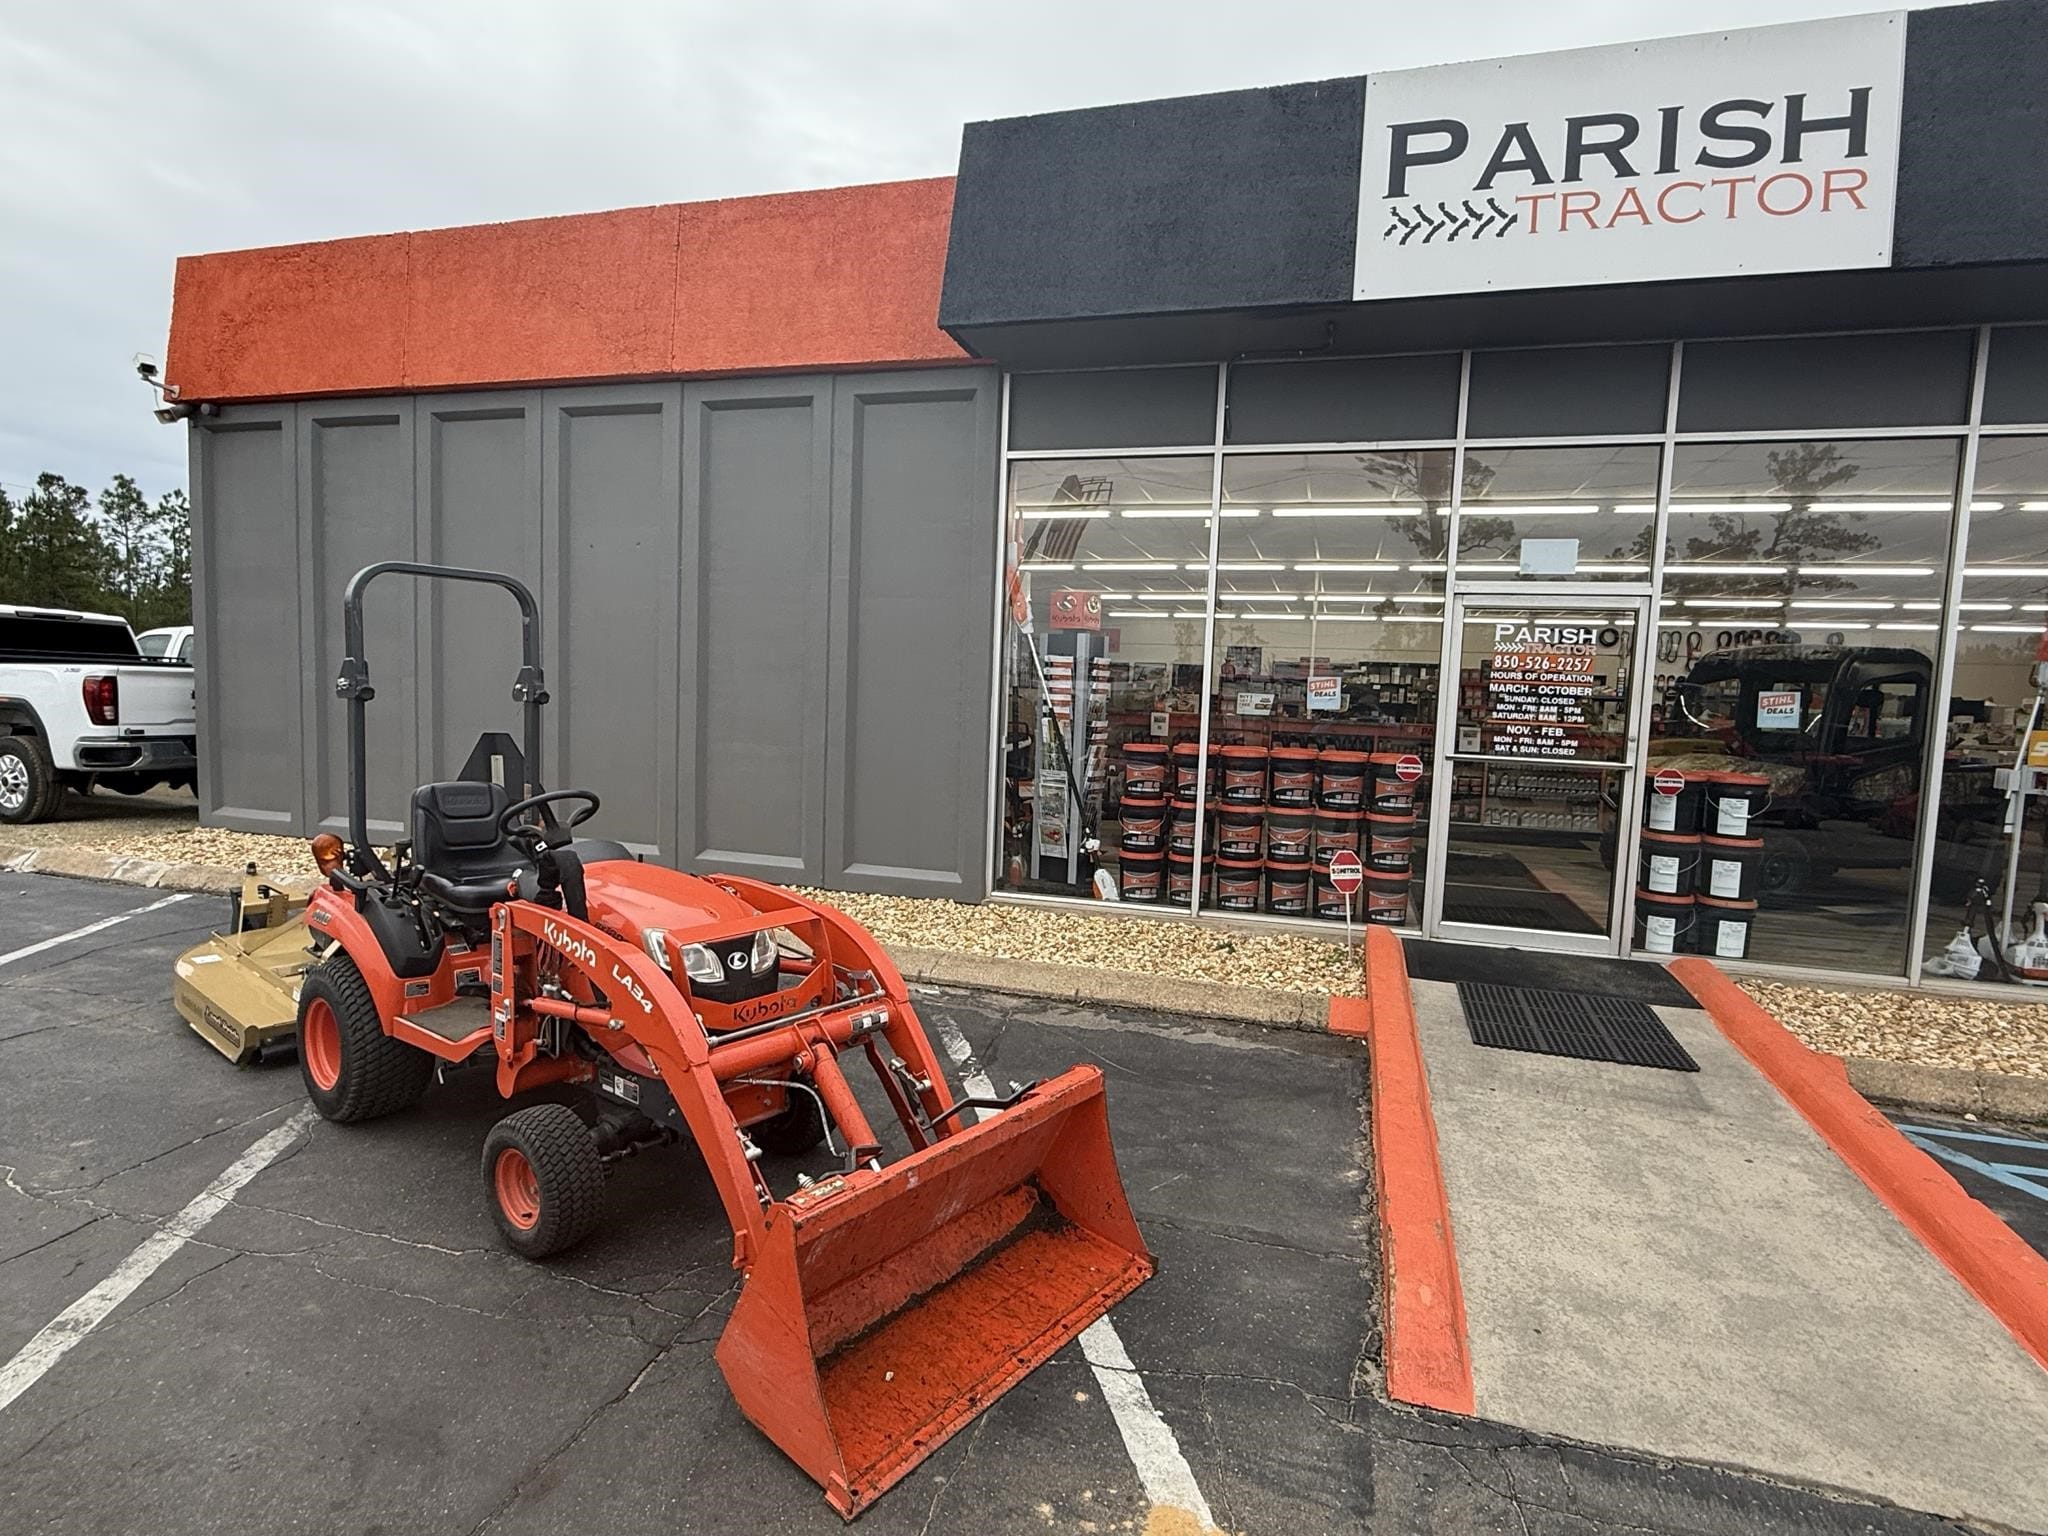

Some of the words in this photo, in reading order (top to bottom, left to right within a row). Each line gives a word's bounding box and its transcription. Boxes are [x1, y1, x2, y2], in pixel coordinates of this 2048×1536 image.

[1382, 87, 1872, 199] PARISH
[1515, 169, 1868, 234] TRACTOR
[1494, 623, 1598, 645] PARISH
[1523, 642, 1597, 656] TRACTOR
[1494, 655, 1592, 672] 850-526-2257
[1490, 671, 1523, 680] HOURS
[1525, 672, 1539, 681] OF
[1540, 673, 1594, 683] OPERATION
[1310, 680, 1336, 690] STIHL
[1489, 683, 1529, 694] MARCH
[1538, 685, 1593, 696] OCTOBER
[1504, 695, 1539, 704] SUNDAY:
[1541, 697, 1576, 705] CLOSED
[1762, 695, 1793, 707] STIHL
[1496, 703, 1516, 711] MON
[1564, 707, 1581, 715] 5PM
[1766, 707, 1794, 715] DEALS
[1492, 711, 1537, 721] SATURDAY:
[1563, 715, 1585, 723] 12PM
[1506, 725, 1532, 735] NOV.
[1541, 727, 1566, 737] FEB.
[1561, 739, 1578, 747] 5PM
[1494, 744, 1511, 752] SAT
[1541, 746, 1576, 756] CLOSED
[1331, 867, 1361, 875] SONITROL
[544, 918, 596, 968] Kubota
[612, 963, 654, 1014] LA34
[734, 995, 797, 1023] Kubota
